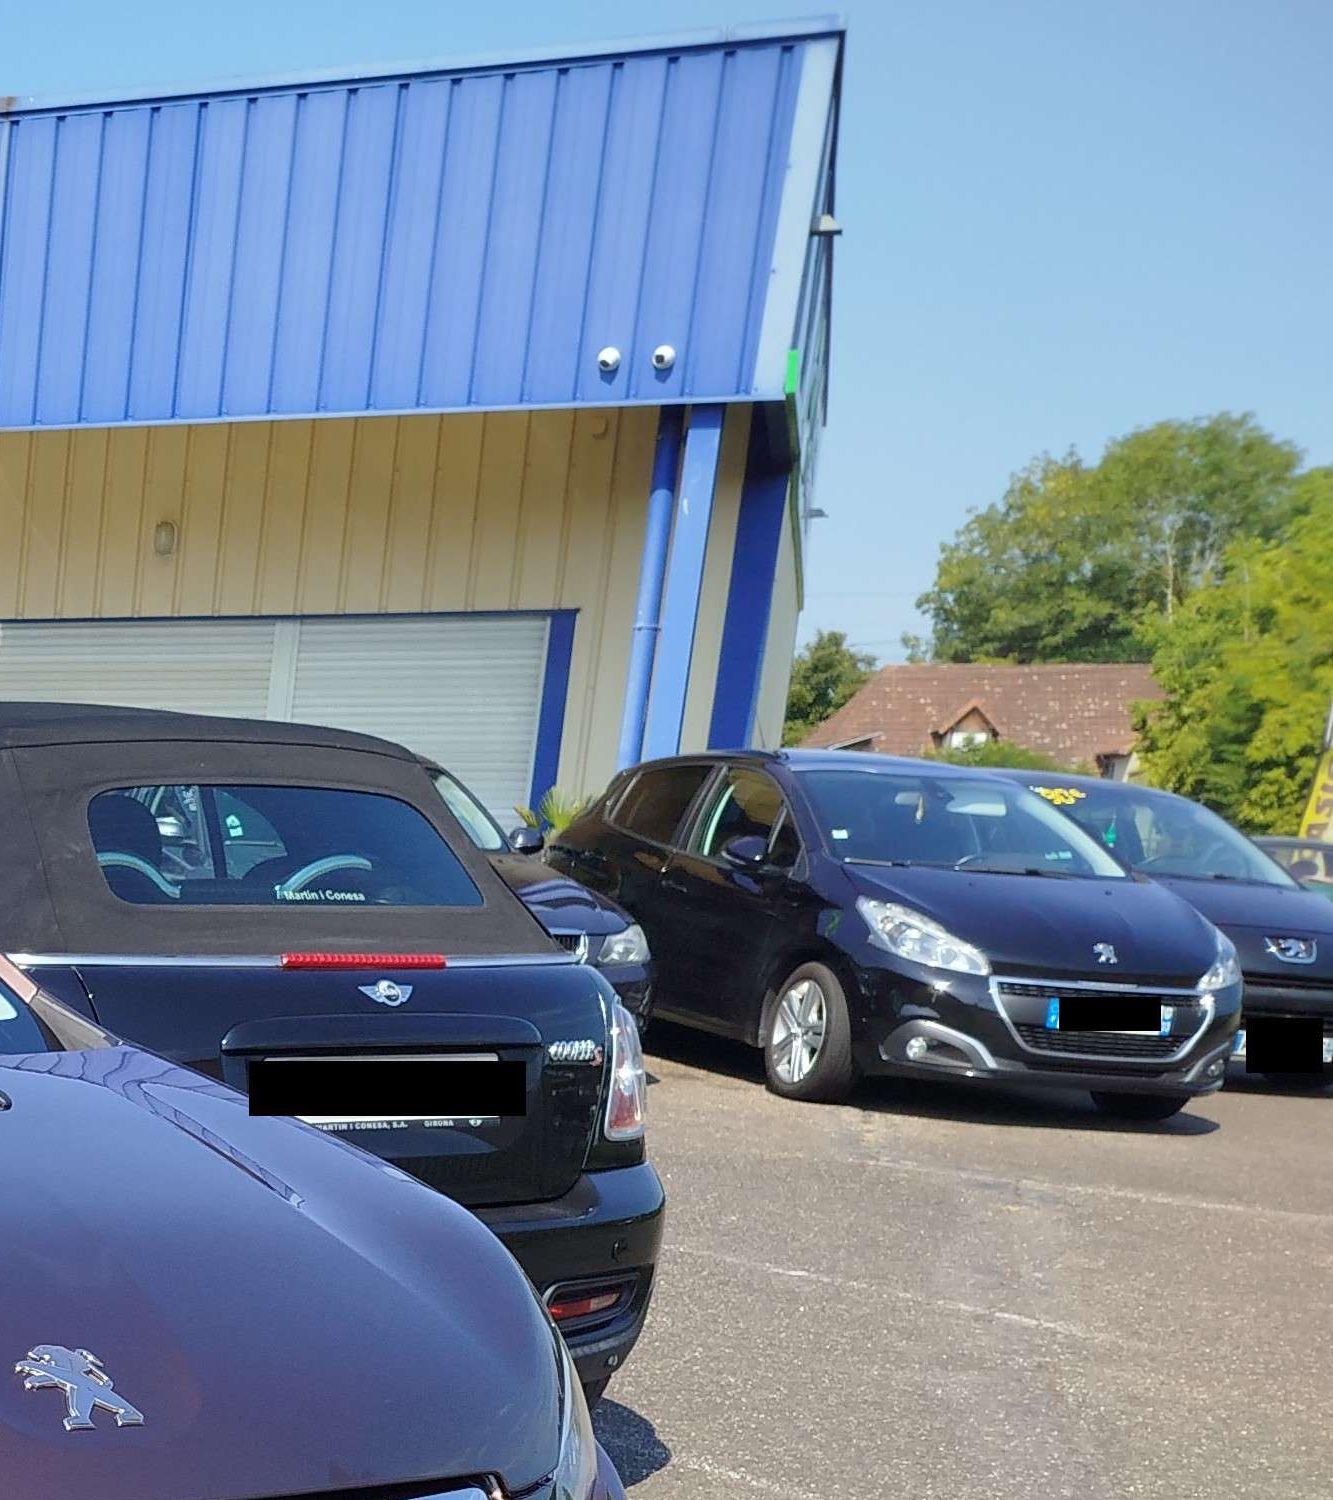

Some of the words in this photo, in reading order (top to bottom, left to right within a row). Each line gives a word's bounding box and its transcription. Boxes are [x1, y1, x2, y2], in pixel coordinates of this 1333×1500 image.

[284, 889, 320, 901] Martin
[325, 889, 366, 902] Conesa
[423, 1119, 455, 1128] GIRONA
